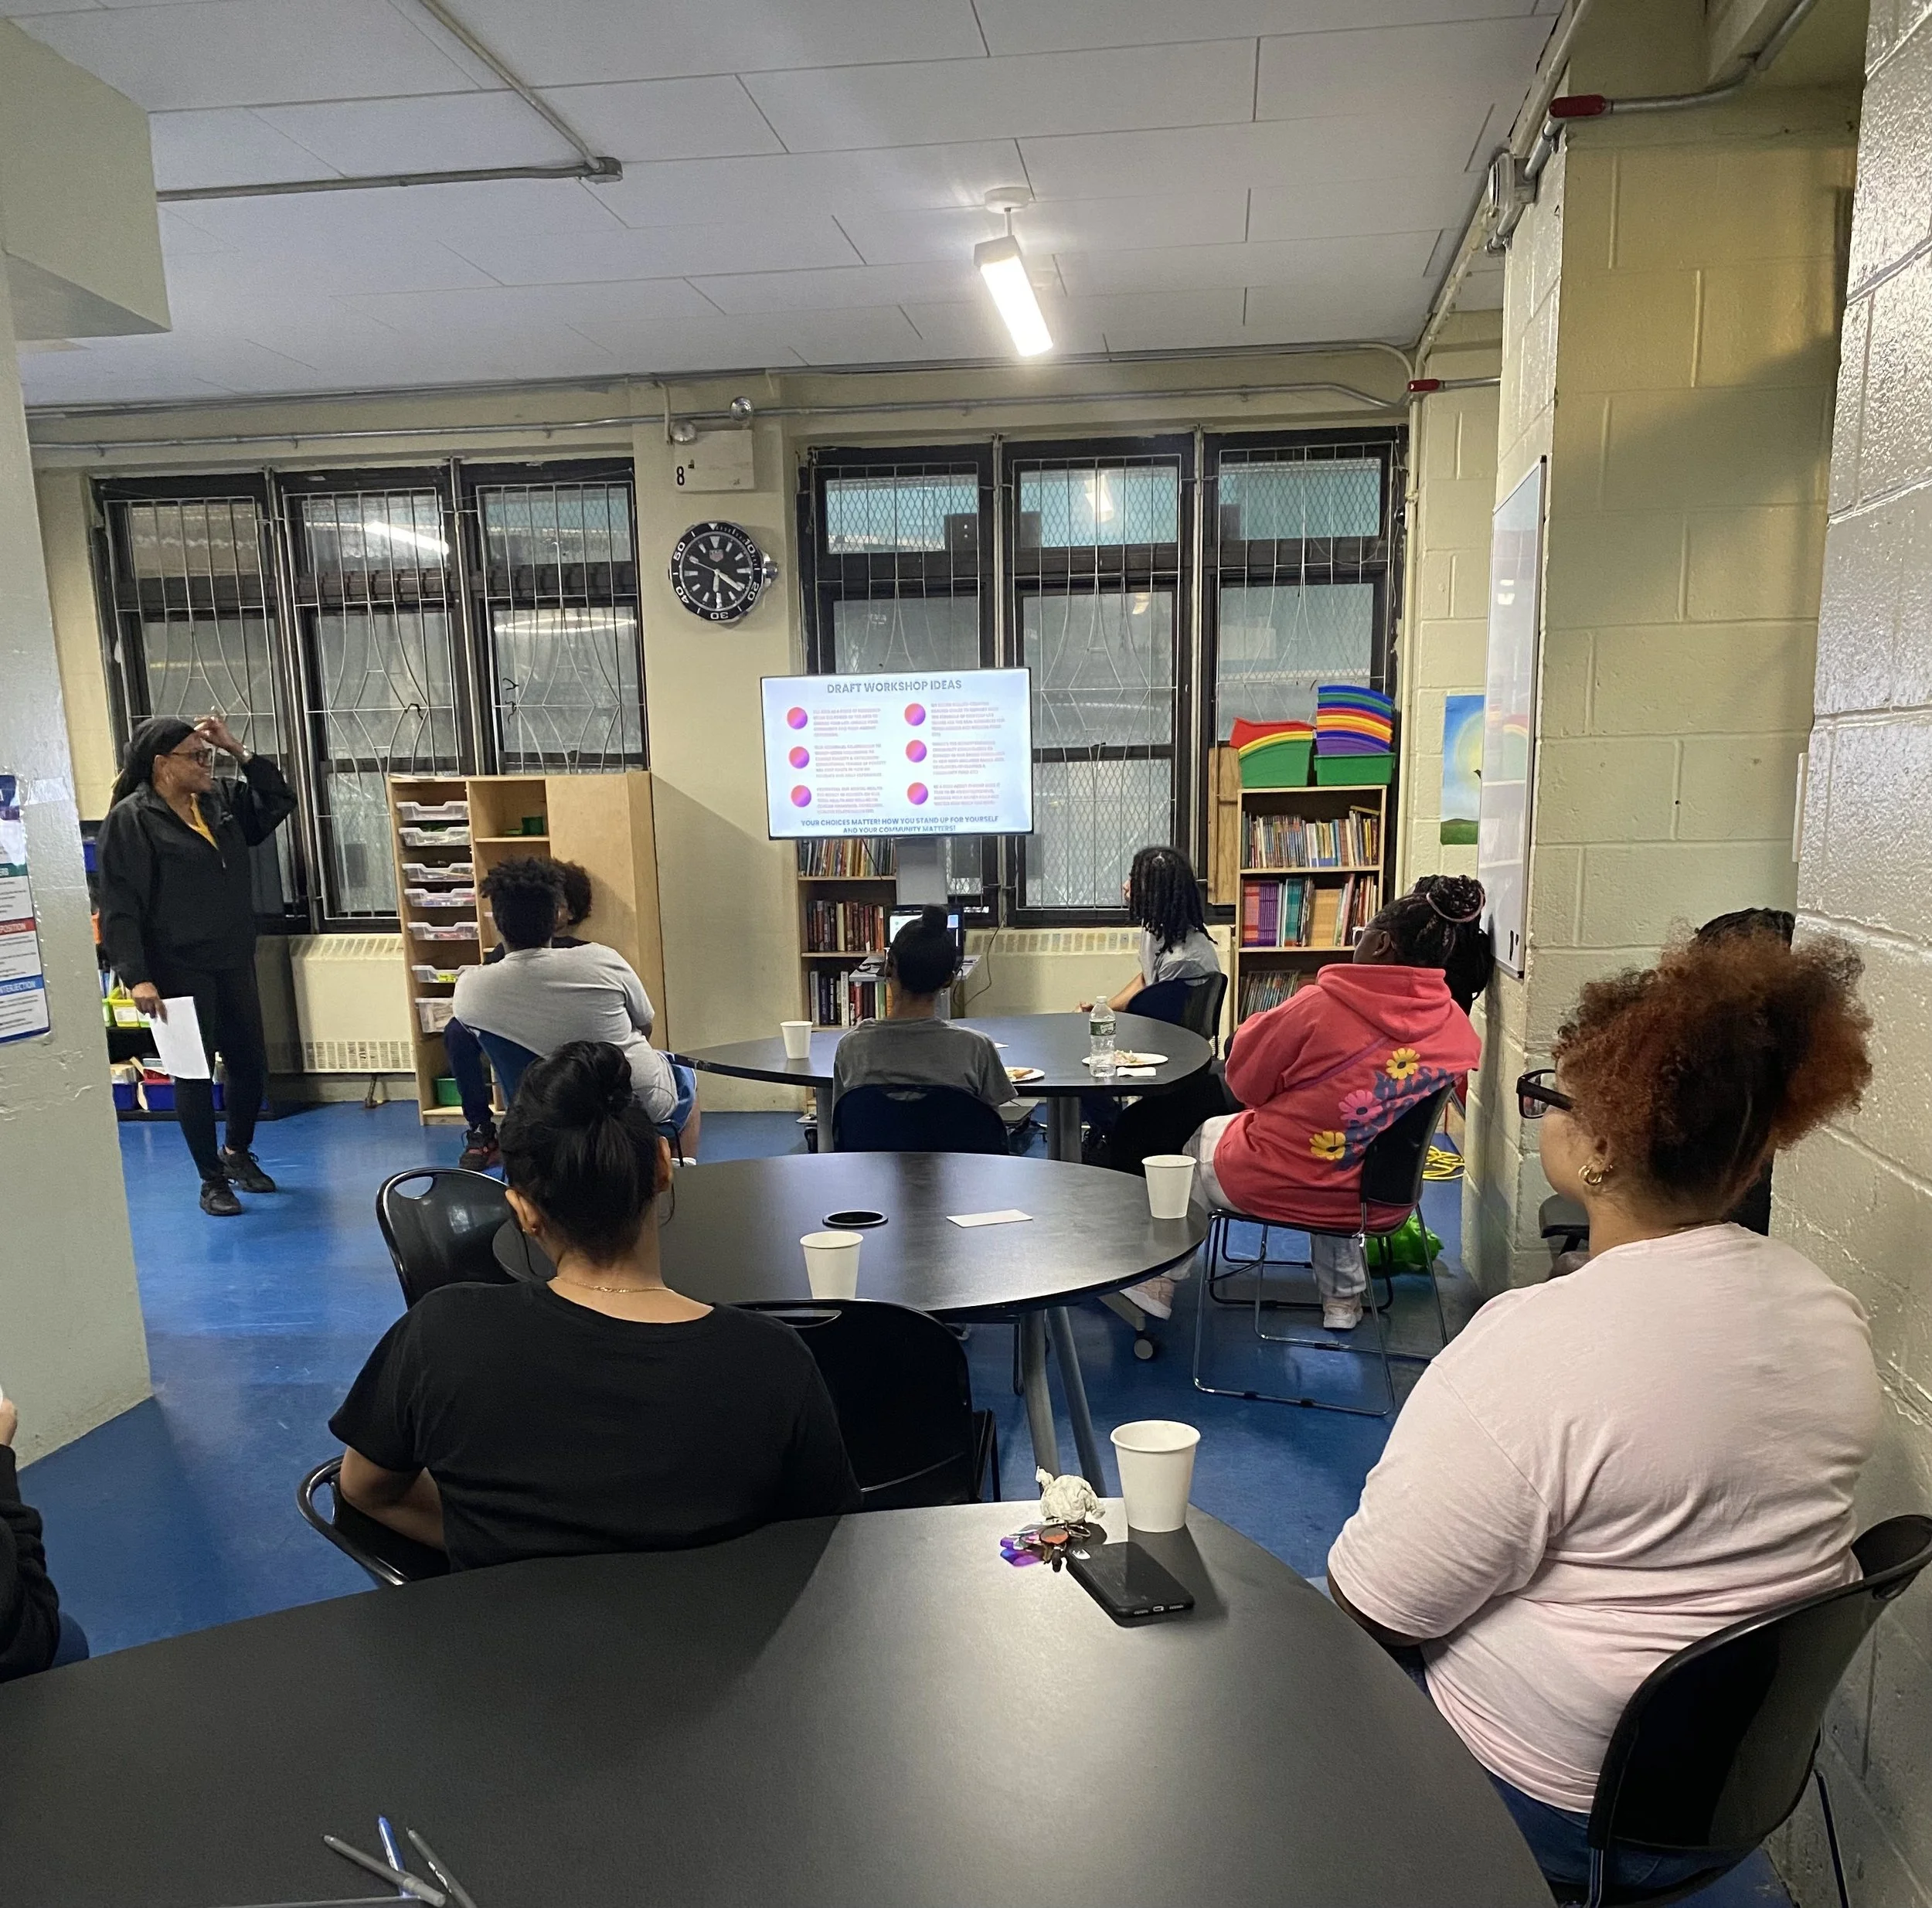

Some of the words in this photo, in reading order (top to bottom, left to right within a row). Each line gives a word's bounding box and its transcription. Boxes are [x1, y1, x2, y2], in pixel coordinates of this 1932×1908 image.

[676, 466, 685, 486] 8
[744, 539, 756, 554] 10
[675, 586, 689, 604] 40
[747, 581, 760, 601] 20
[709, 611, 729, 620] 30
[827, 683, 862, 693] DRAFT
[864, 681, 928, 692] WORKSHOP
[930, 679, 962, 690] IDEAS
